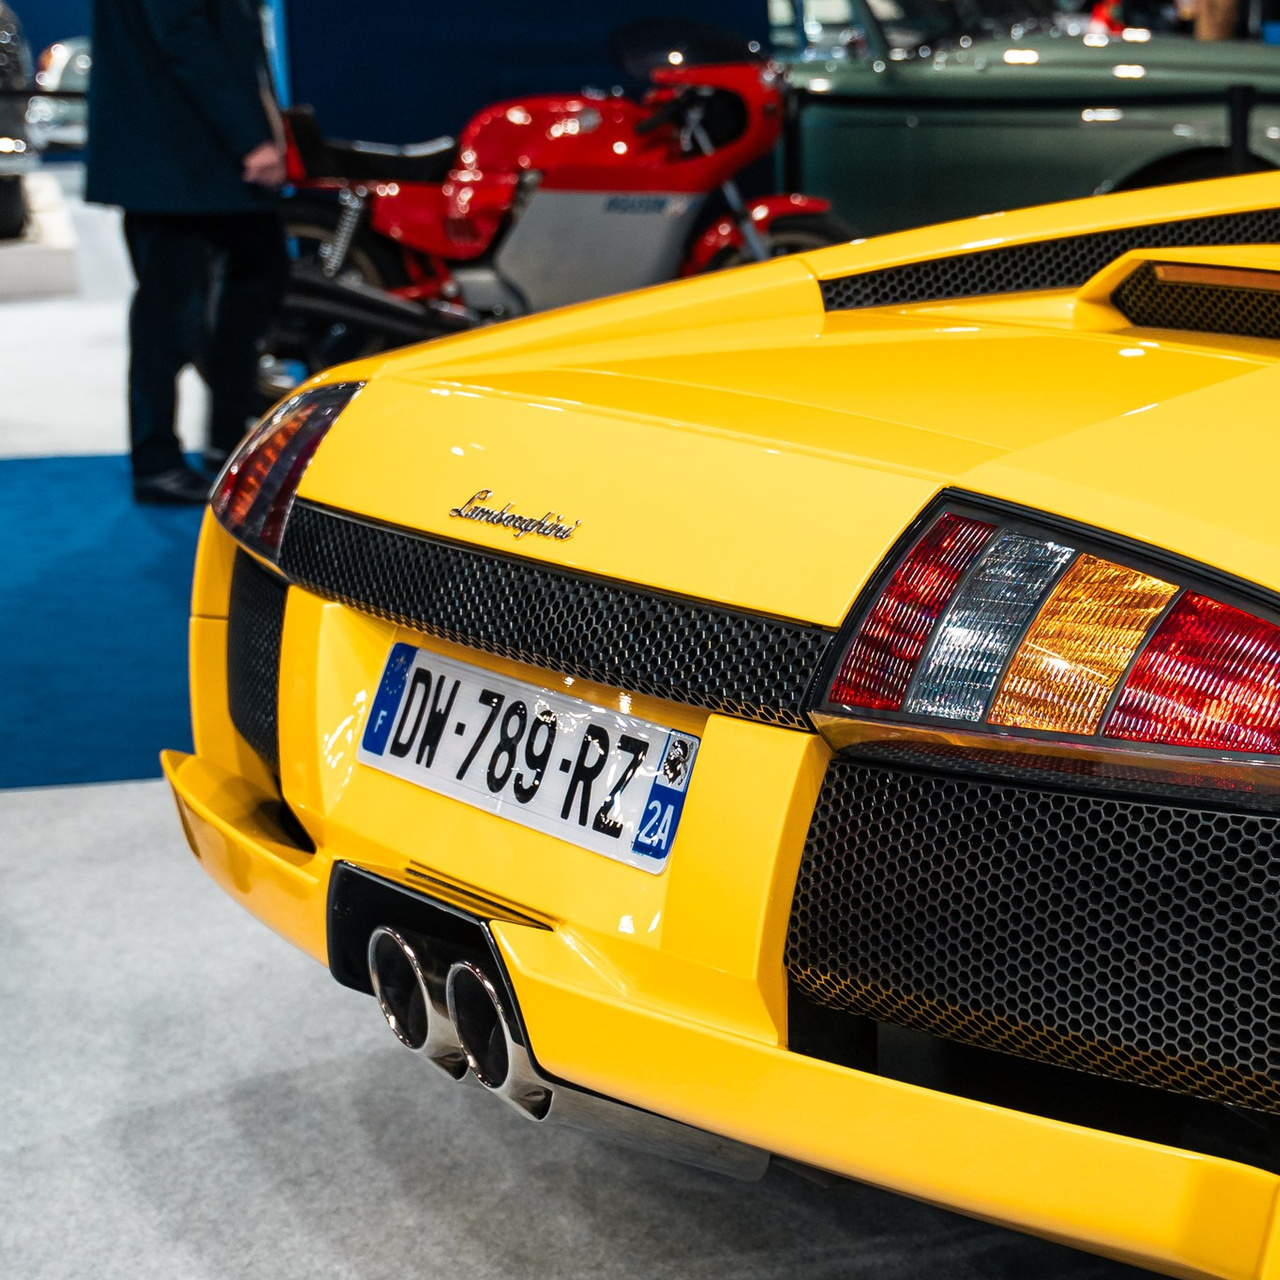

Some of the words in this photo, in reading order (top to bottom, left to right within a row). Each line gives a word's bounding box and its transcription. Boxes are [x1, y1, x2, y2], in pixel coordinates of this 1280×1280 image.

[449, 489, 581, 541] Lamborghini
[371, 709, 388, 733] F
[390, 666, 650, 839] DW-789-RZ
[638, 799, 675, 851] 2A
